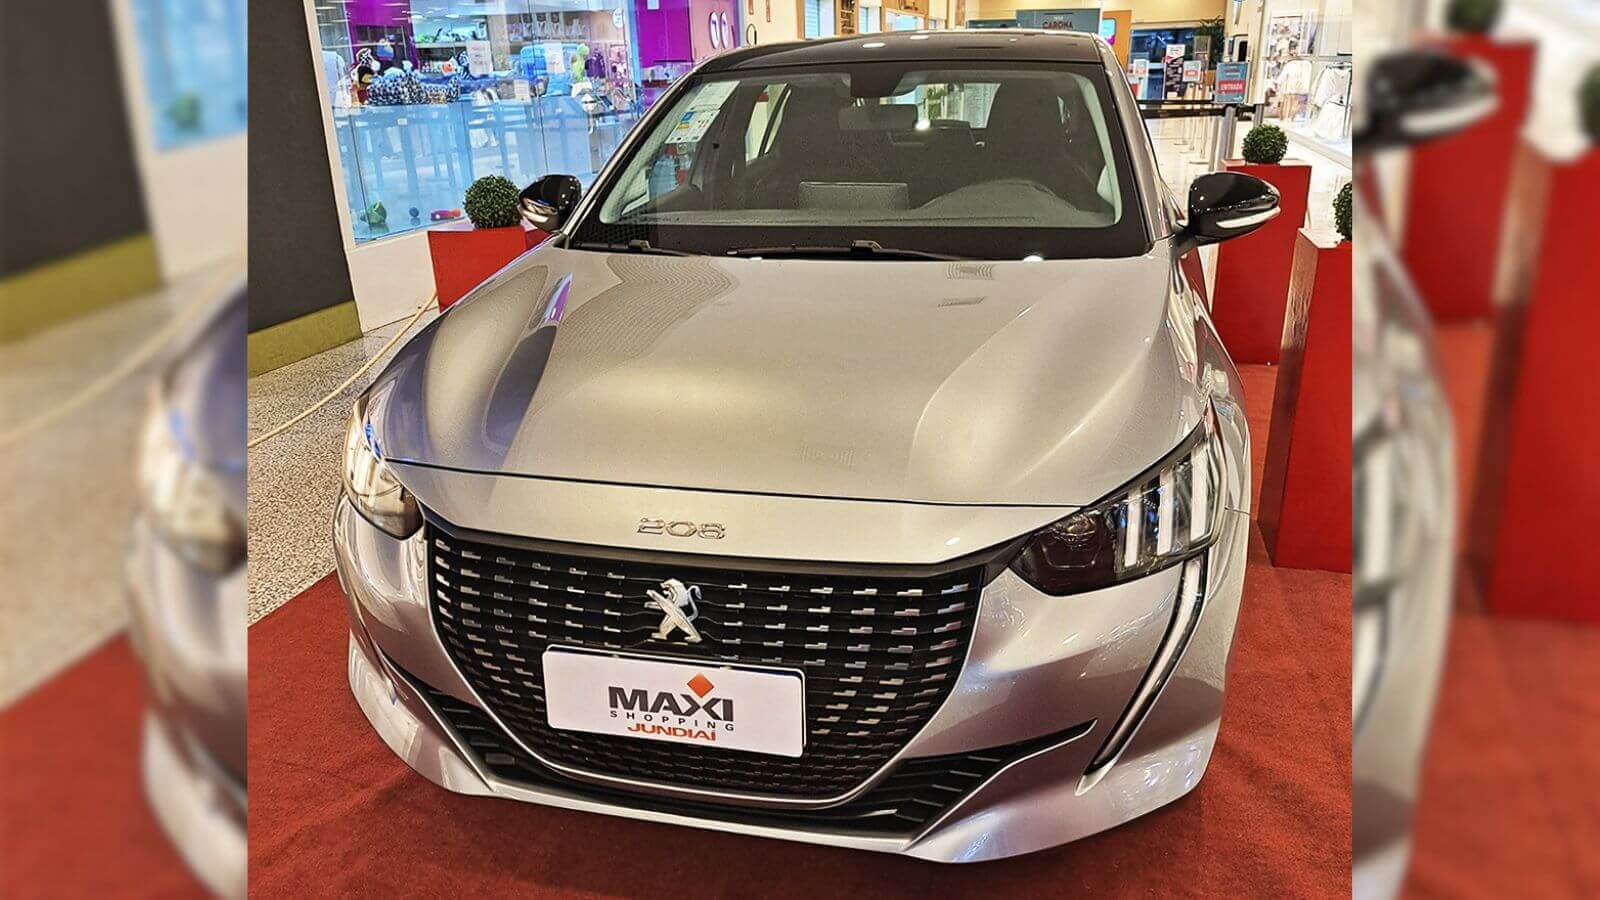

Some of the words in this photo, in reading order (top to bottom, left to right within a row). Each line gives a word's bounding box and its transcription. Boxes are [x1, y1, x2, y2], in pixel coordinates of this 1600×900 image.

[637, 518, 726, 539] 208
[608, 686, 734, 722] MAXI
[610, 710, 734, 731] SHOPPING
